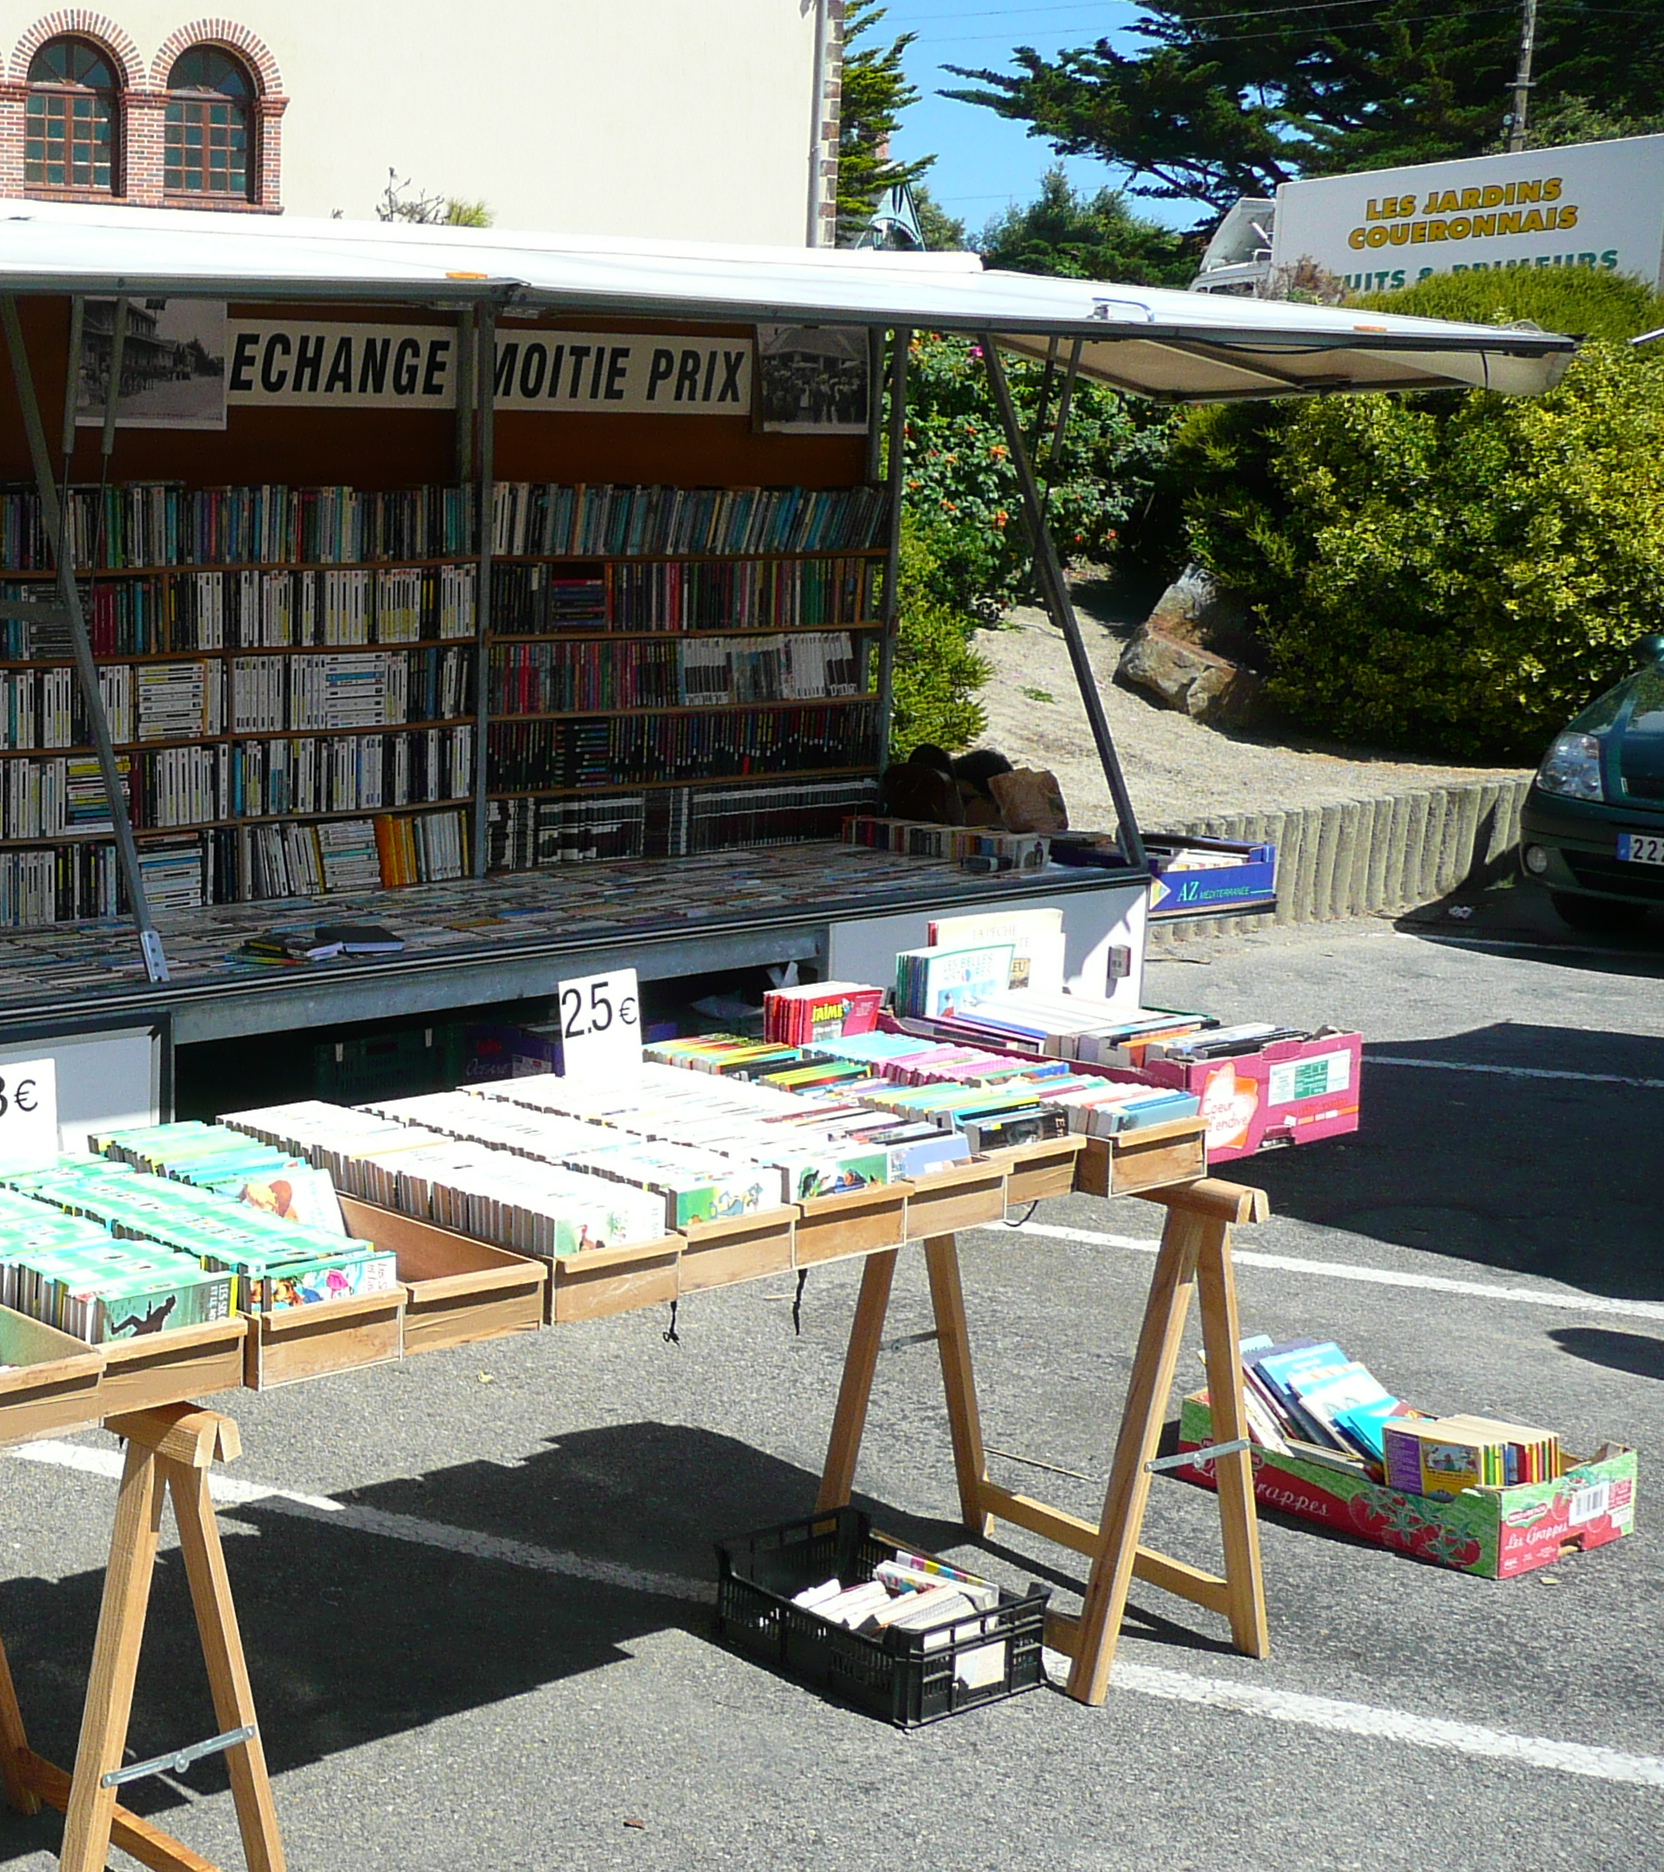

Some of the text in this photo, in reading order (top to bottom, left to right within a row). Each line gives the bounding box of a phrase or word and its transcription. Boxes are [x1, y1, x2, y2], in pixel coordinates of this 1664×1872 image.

[1366, 178, 1563, 221] LES JARDINS
[1347, 205, 1578, 250] COUERONNAIS
[1336, 269, 1406, 292] UITS
[229, 333, 451, 396] ECHANGE
[646, 347, 746, 403] PRIX
[1632, 838, 1664, 863] 22
[1176, 881, 1200, 902] AZ
[1204, 1098, 1235, 1116] Coeur
[217, 1283, 229, 1316] LES SIX
[1251, 1472, 1331, 1517] rappes
[1526, 1522, 1569, 1545] Grappes
